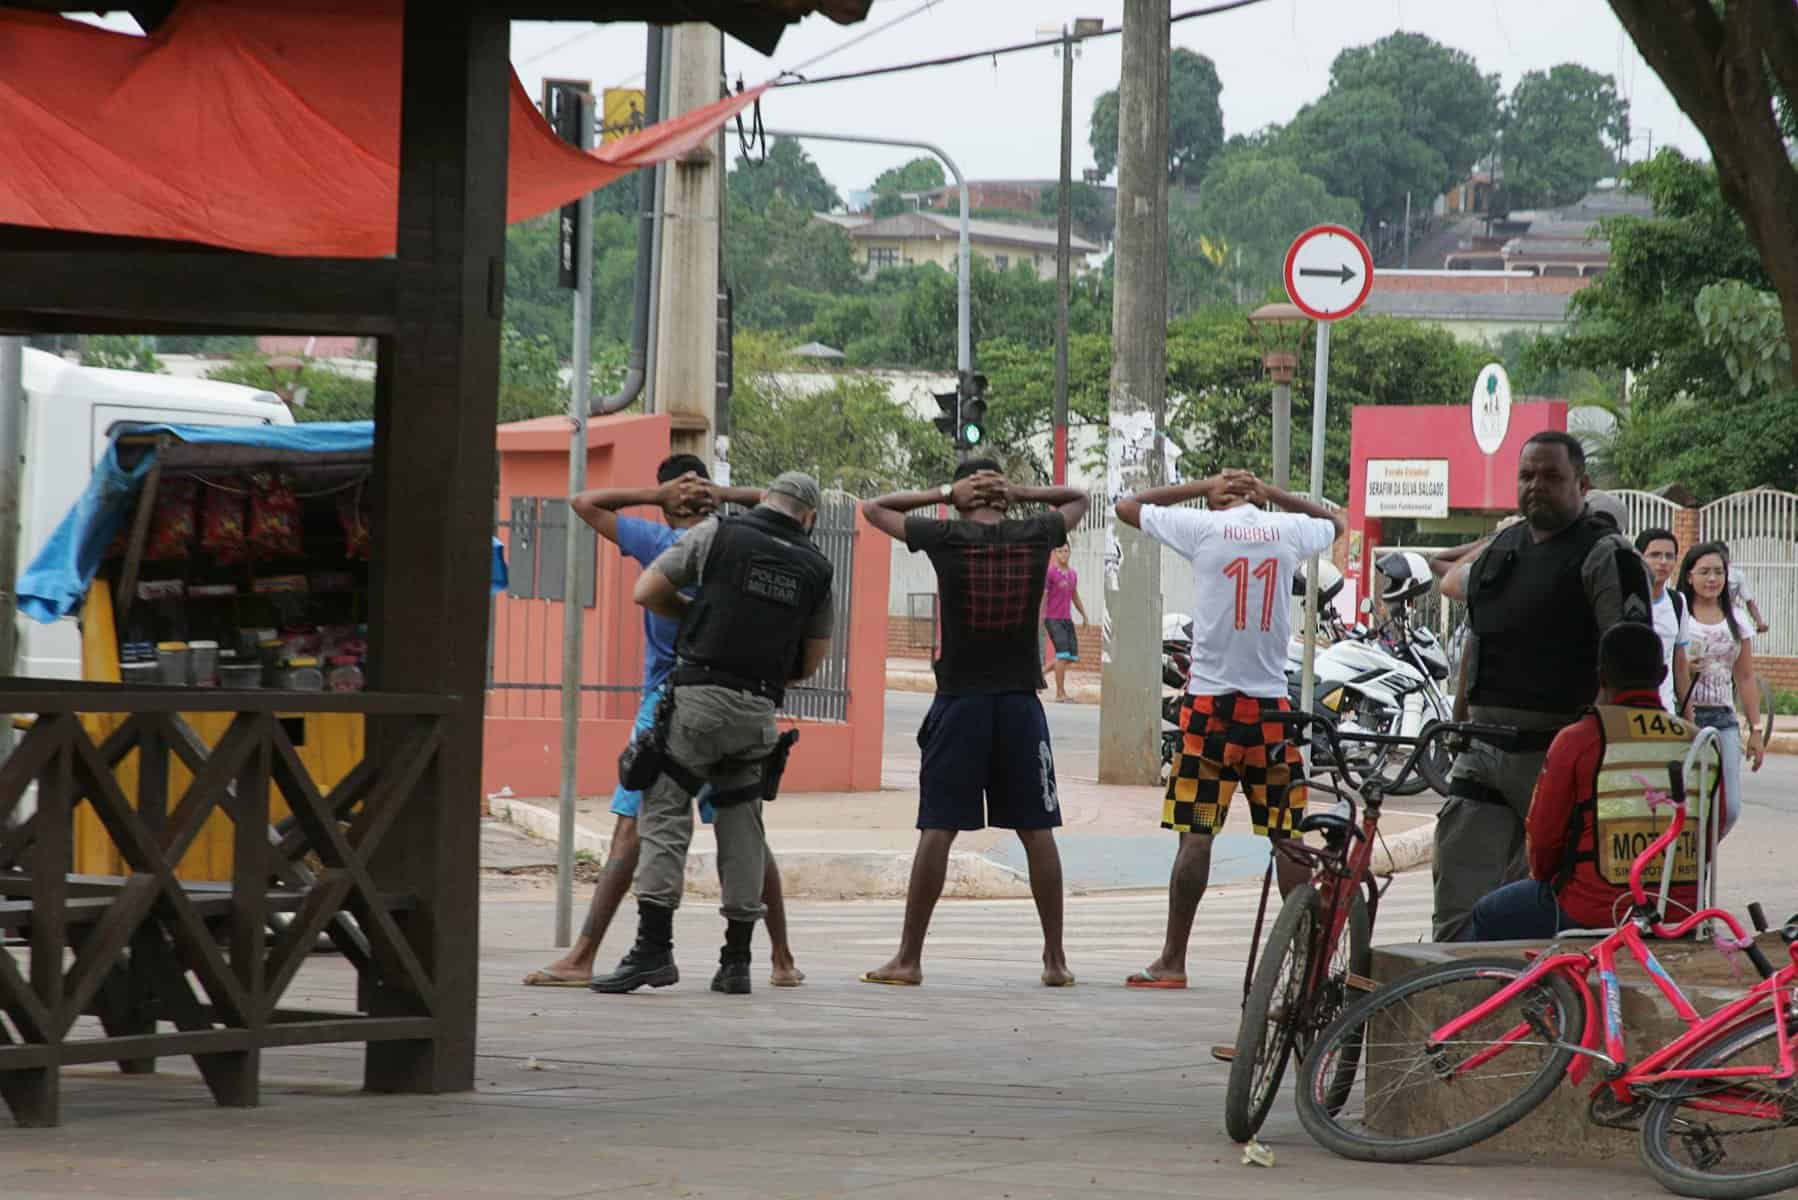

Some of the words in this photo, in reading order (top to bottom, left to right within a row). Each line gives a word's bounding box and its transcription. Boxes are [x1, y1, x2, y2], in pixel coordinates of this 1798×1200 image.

[1368, 481, 1393, 496] SERAFIM
[1394, 481, 1401, 496] DA
[1402, 481, 1417, 496] SILVA
[1418, 481, 1444, 496] SALGADO
[1223, 557, 1280, 632] 11
[1632, 713, 1685, 736] 146
